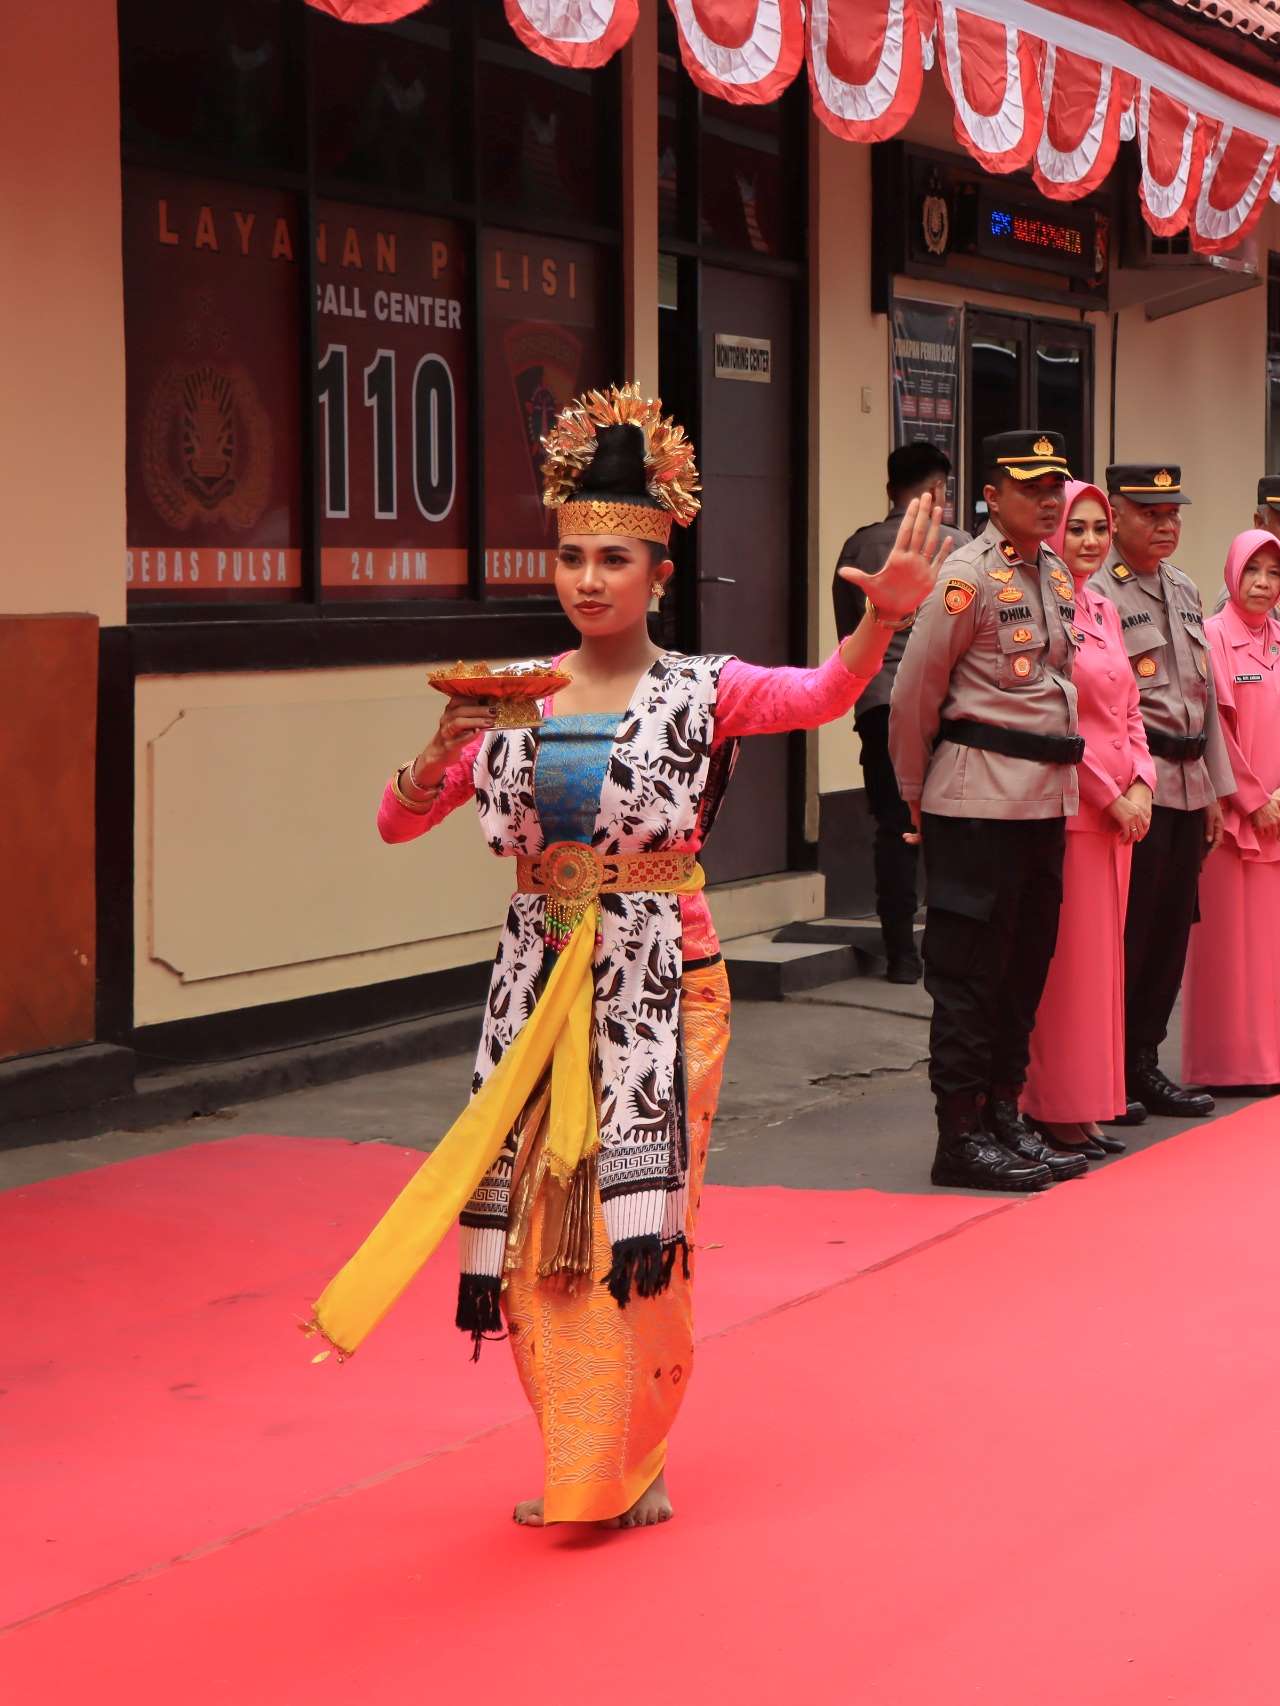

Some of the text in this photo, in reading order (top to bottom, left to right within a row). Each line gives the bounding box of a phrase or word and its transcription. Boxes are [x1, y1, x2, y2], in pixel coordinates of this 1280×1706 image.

[431, 240, 577, 299] PLISI
[373, 290, 462, 329] CENTER
[749, 345, 769, 373] CENTER
[941, 343, 956, 364] 2024
[317, 343, 457, 522] 110
[127, 551, 287, 582] BEBAS PULSA
[352, 551, 427, 580] 24 JAM
